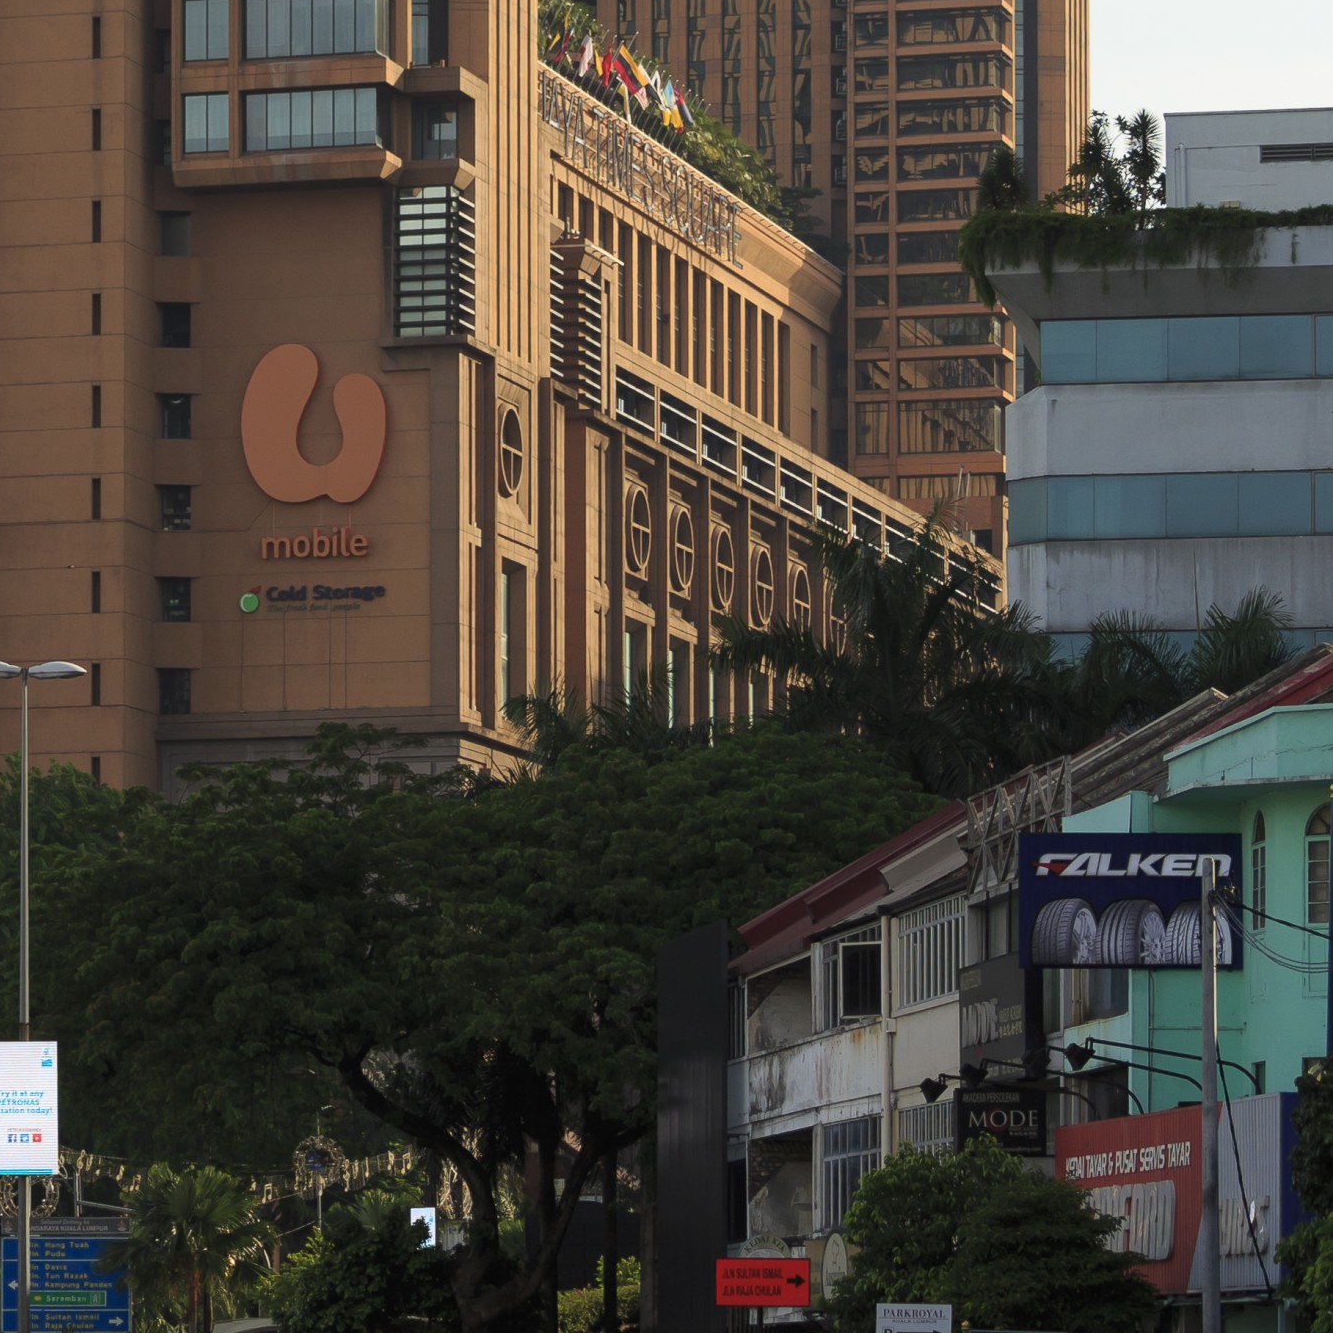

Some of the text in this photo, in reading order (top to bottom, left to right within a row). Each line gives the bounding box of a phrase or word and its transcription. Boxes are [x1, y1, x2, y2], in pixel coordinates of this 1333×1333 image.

[261, 526, 369, 560] mobile
[266, 583, 386, 602] Cold Storage
[1033, 852, 1232, 877] FALKEN
[969, 1110, 1038, 1128] MODE
[1085, 1153, 1107, 1178] TAYAR
[1114, 1149, 1138, 1175] PUSAT
[1139, 1144, 1166, 1172] SERVIS
[1167, 1141, 1191, 1168] TAYAR
[736, 1268, 761, 1279] SULTAN
[762, 1268, 784, 1279] ISMAIL
[736, 1285, 754, 1296] RAJA
[755, 1285, 782, 1296] CHULAN
[883, 1308, 945, 1318] PARKROYAL
